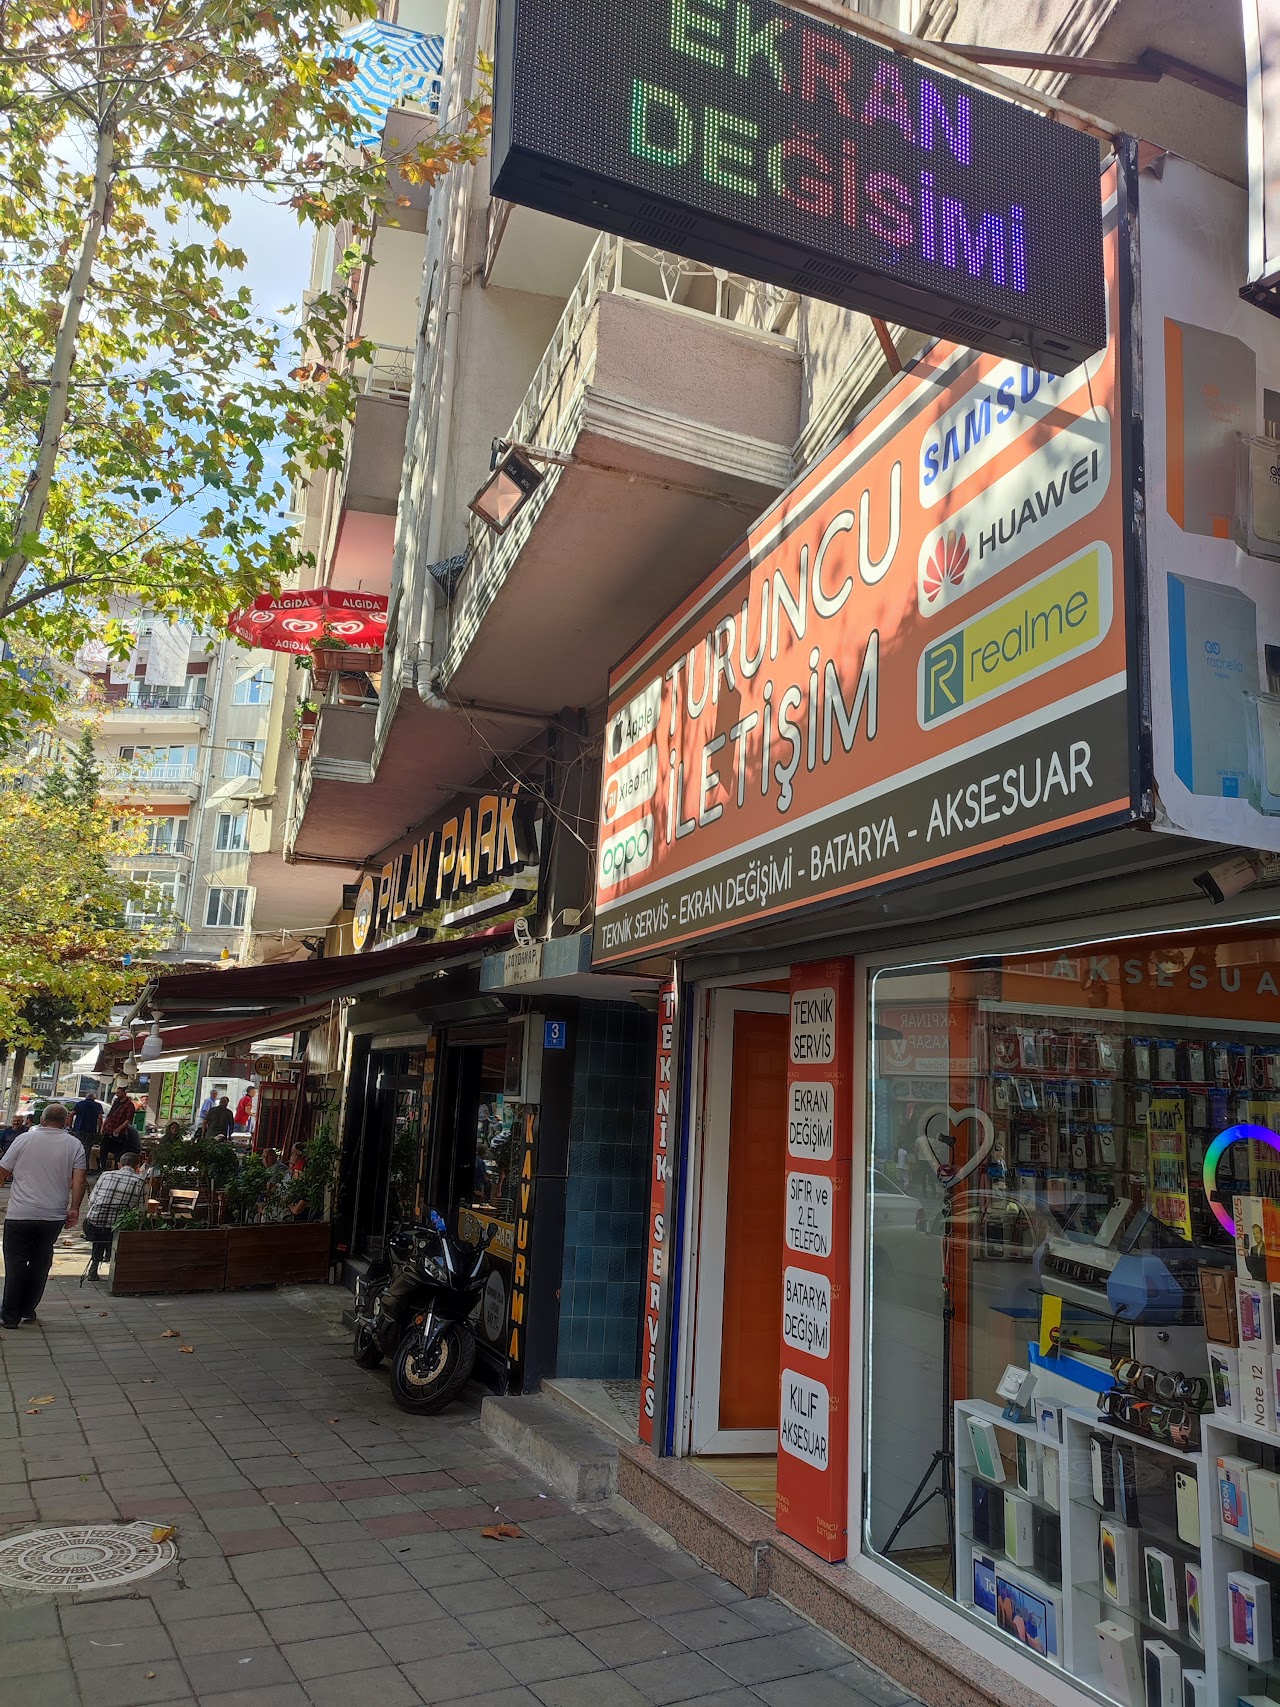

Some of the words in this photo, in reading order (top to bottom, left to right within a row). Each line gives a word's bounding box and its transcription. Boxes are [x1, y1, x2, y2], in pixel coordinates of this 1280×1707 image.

[671, 0, 972, 166] EKRAN
[630, 77, 1027, 293] DEĞİŞİMİ
[923, 363, 1056, 488] SAMSU
[978, 448, 1098, 559] HUAWEI
[665, 460, 902, 738] TURUNCU
[970, 590, 1088, 682] realme
[624, 706, 653, 743] Apple
[665, 629, 880, 845] İLETİŞİM
[435, 782, 520, 899] PARK
[601, 911, 632, 951] TEKNİK
[634, 898, 669, 937] SERVİS
[679, 881, 723, 925] EKRAN
[725, 846, 793, 907] DEĞİŞİMİ
[810, 816, 900, 882] BATARYA
[925, 740, 1094, 843] AKSESUAR
[602, 828, 649, 880] oppo
[793, 992, 833, 1025] TEKNİK
[551, 1023, 559, 1038] 3
[793, 1027, 831, 1059] SERVİS
[655, 990, 675, 1183] TEKNİK
[794, 1088, 829, 1113] EKRAN
[789, 1116, 833, 1153] DEĞİŞİMİ
[790, 1178, 813, 1203] SIFIR
[815, 1187, 829, 1205] ve
[508, 1111, 535, 1362] KAVURMA
[807, 1208, 818, 1228] EL
[1233, 1197, 1245, 1241] SPARK
[790, 1227, 827, 1254] TELEFON
[644, 1211, 665, 1420] SERVİS
[786, 1280, 828, 1313] BATARYA
[785, 1311, 828, 1350] DEĞİŞİMİ
[1252, 1365, 1263, 1380] 12
[789, 1383, 819, 1419] KILIF
[1255, 1386, 1265, 1427] Note
[781, 1421, 827, 1463] AKSESUAR
[1222, 1483, 1231, 1511] Note
[1224, 1510, 1232, 1521] 10
